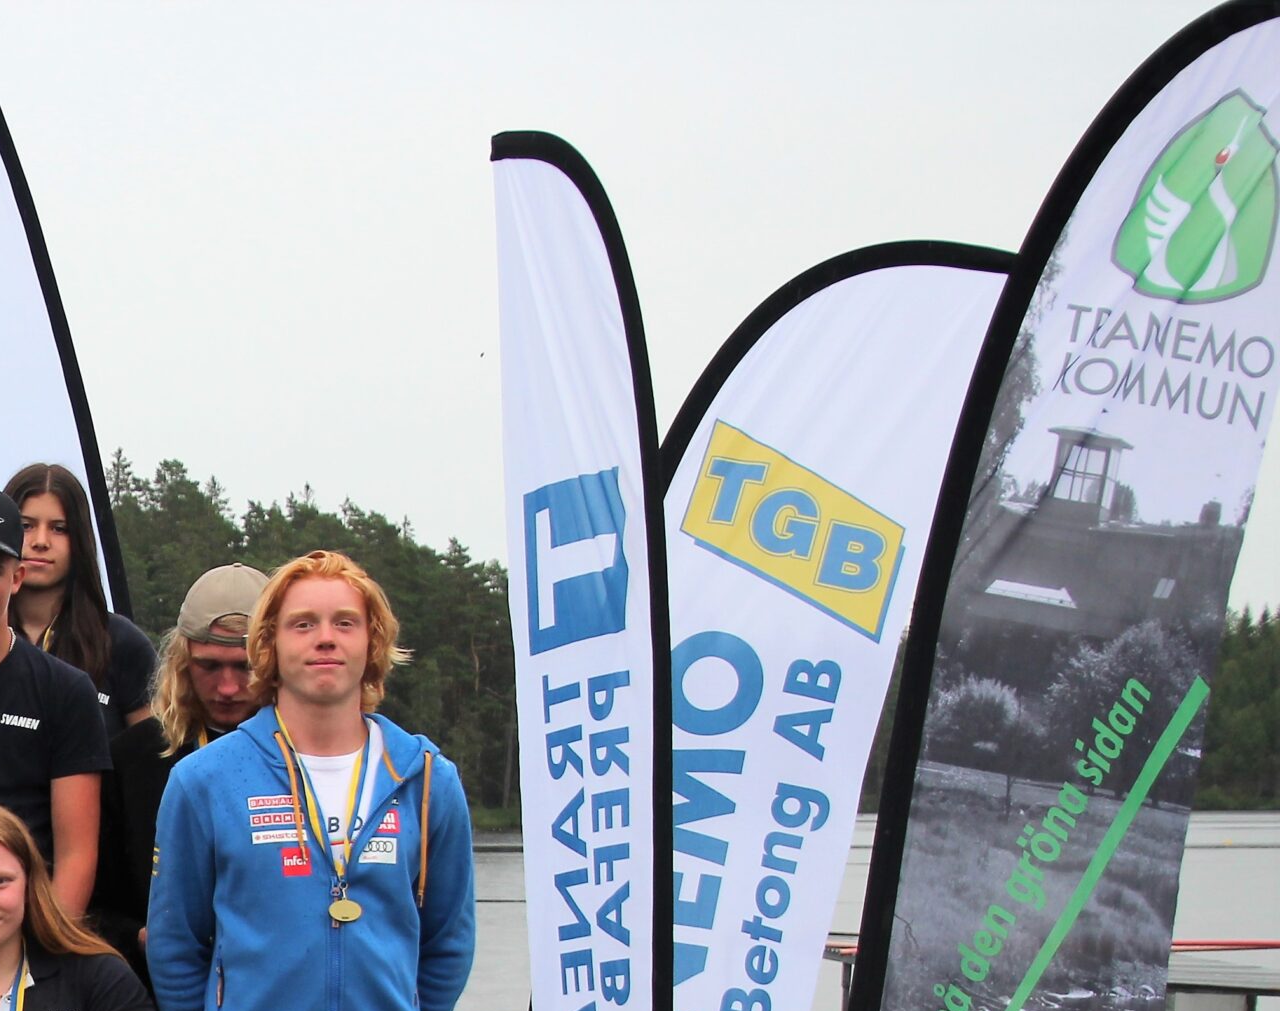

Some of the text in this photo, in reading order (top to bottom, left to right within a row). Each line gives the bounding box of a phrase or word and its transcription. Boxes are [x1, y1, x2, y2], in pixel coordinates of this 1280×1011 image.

[1067, 303, 1275, 378] TRANEMO
[1052, 352, 1266, 432] KOMMUN
[706, 455, 888, 596] TGB
[0, 712, 40, 731] SVANEN
[773, 658, 842, 762] AB
[250, 798, 295, 808] BAUHAU
[252, 814, 302, 825] CRAM
[262, 831, 305, 840] skista
[957, 904, 1017, 982] den
[1004, 779, 1090, 912] gröna
[1074, 676, 1152, 788] sidan
